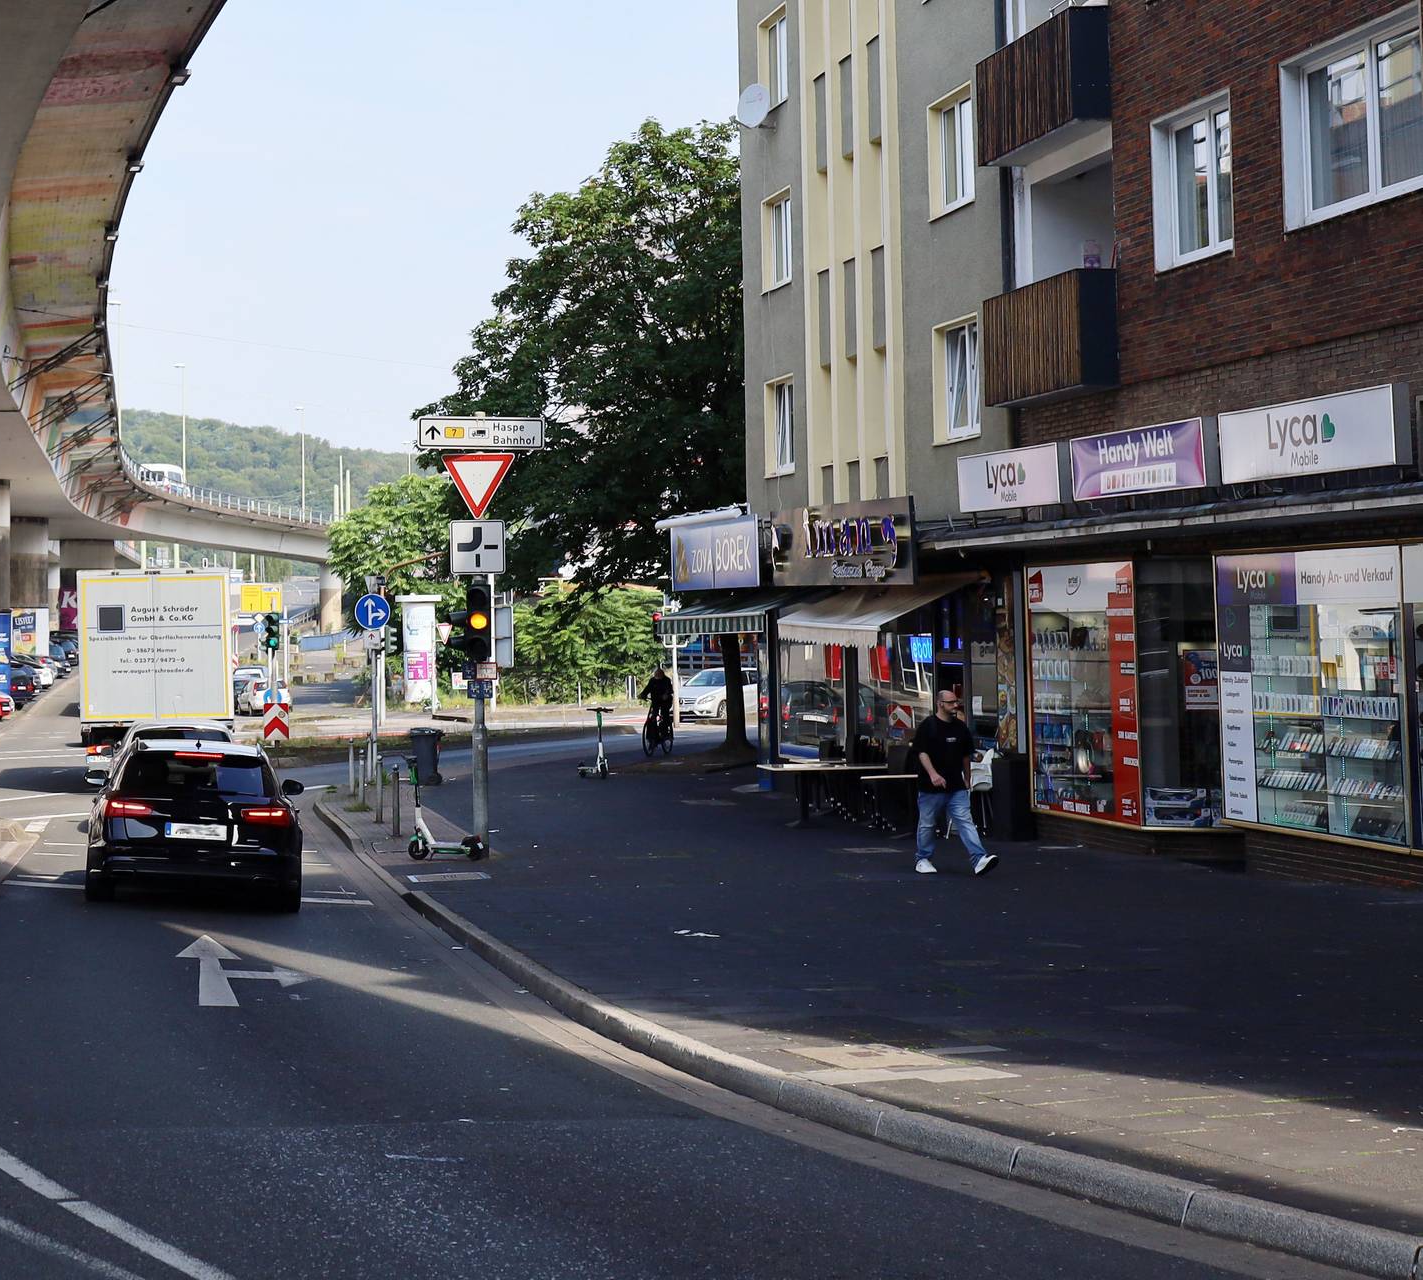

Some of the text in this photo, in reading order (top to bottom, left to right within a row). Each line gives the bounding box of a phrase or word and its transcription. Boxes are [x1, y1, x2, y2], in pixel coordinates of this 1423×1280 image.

[452, 422, 525, 437] 7 Haspe
[1267, 413, 1317, 457] Lyca
[493, 436, 536, 445] Bahnhof
[1097, 429, 1175, 467] Handy Welt
[1291, 450, 1319, 468] Mobile
[985, 460, 1017, 494] Lyca
[1001, 490, 1017, 502] Mobile
[691, 532, 752, 574] ZOYA BÖREK
[1236, 567, 1266, 593] Lyca
[1300, 566, 1394, 587] Handy An- und Verkauf
[130, 605, 159, 614] August
[130, 614, 155, 622] GmbH
[1223, 642, 1243, 660] Lyca
